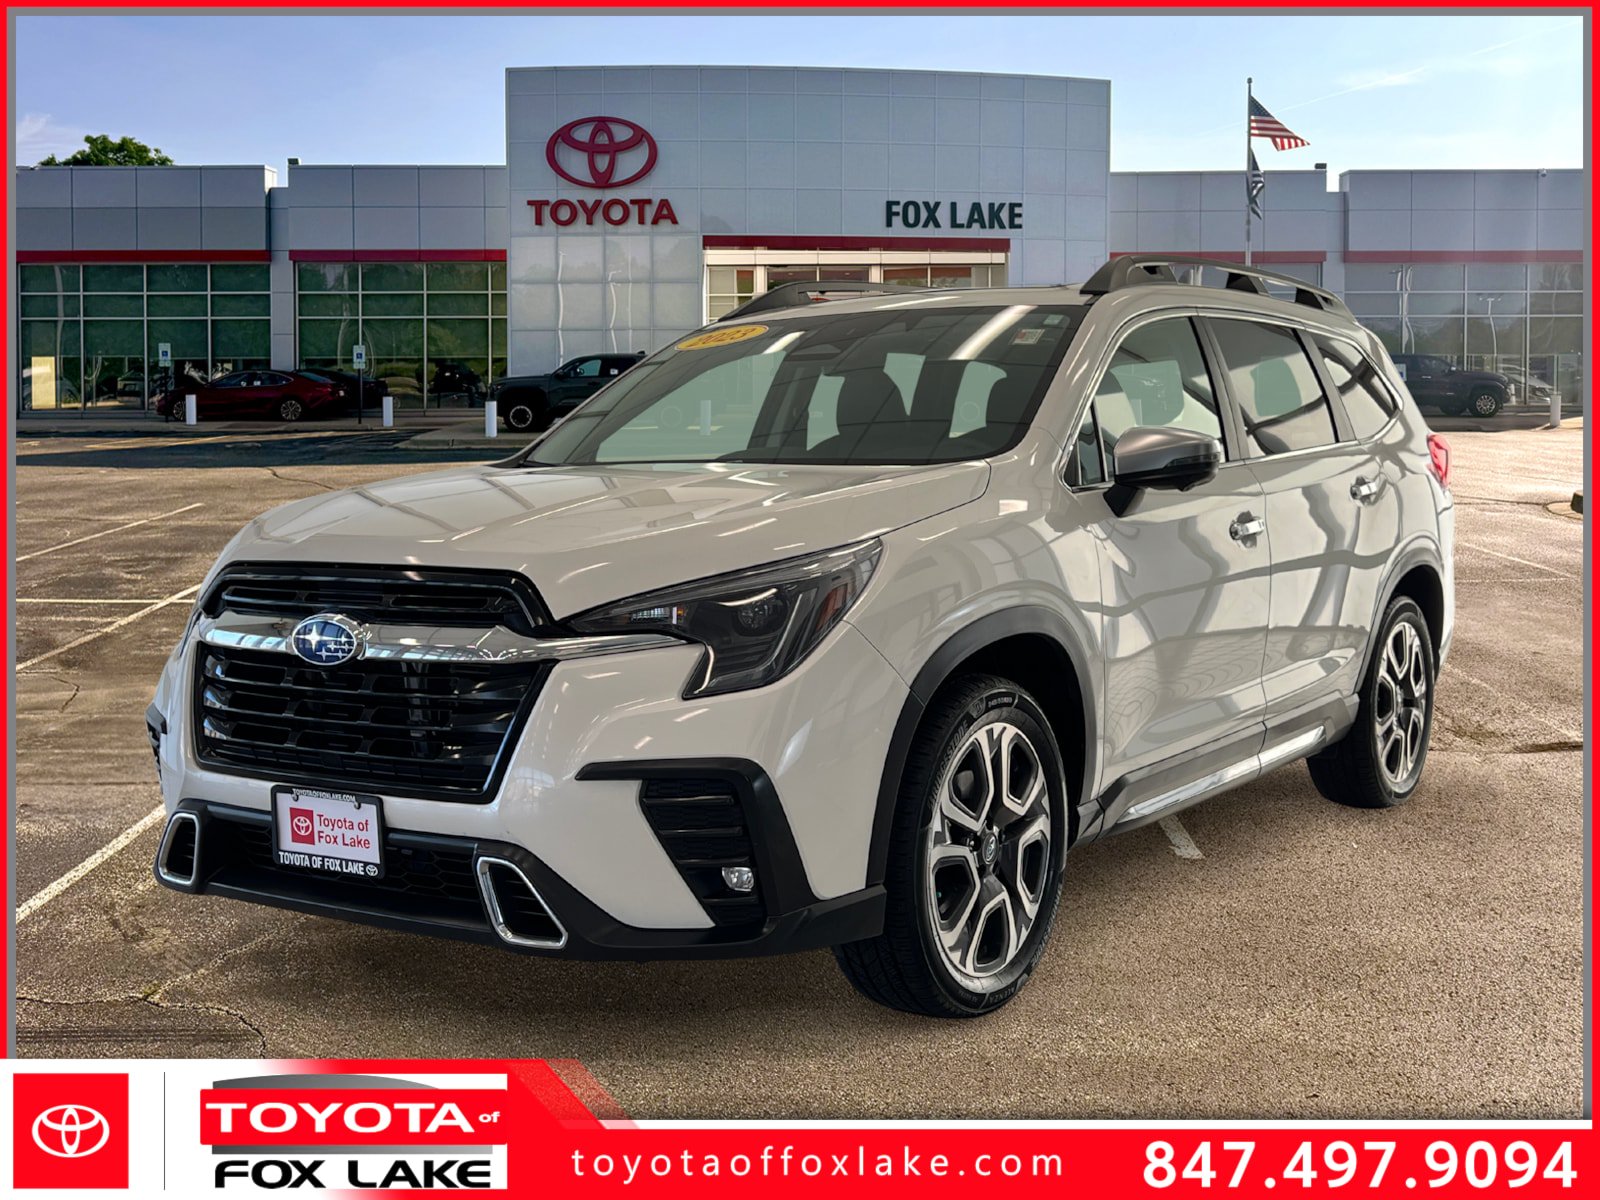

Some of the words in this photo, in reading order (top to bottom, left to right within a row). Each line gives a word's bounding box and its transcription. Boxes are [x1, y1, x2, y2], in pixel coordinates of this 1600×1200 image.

[527, 198, 679, 226] TOYOTA
[885, 200, 941, 228] FOX
[949, 202, 1023, 229] LAKE
[687, 327, 758, 348] 2023
[317, 814, 354, 831] Toyota
[357, 819, 369, 832] of
[317, 830, 339, 845] Fox
[342, 833, 370, 849] Lake
[279, 851, 310, 868] TOYOTA
[311, 856, 323, 869] OF
[324, 858, 341, 872] FOX
[342, 861, 365, 875] LAKE
